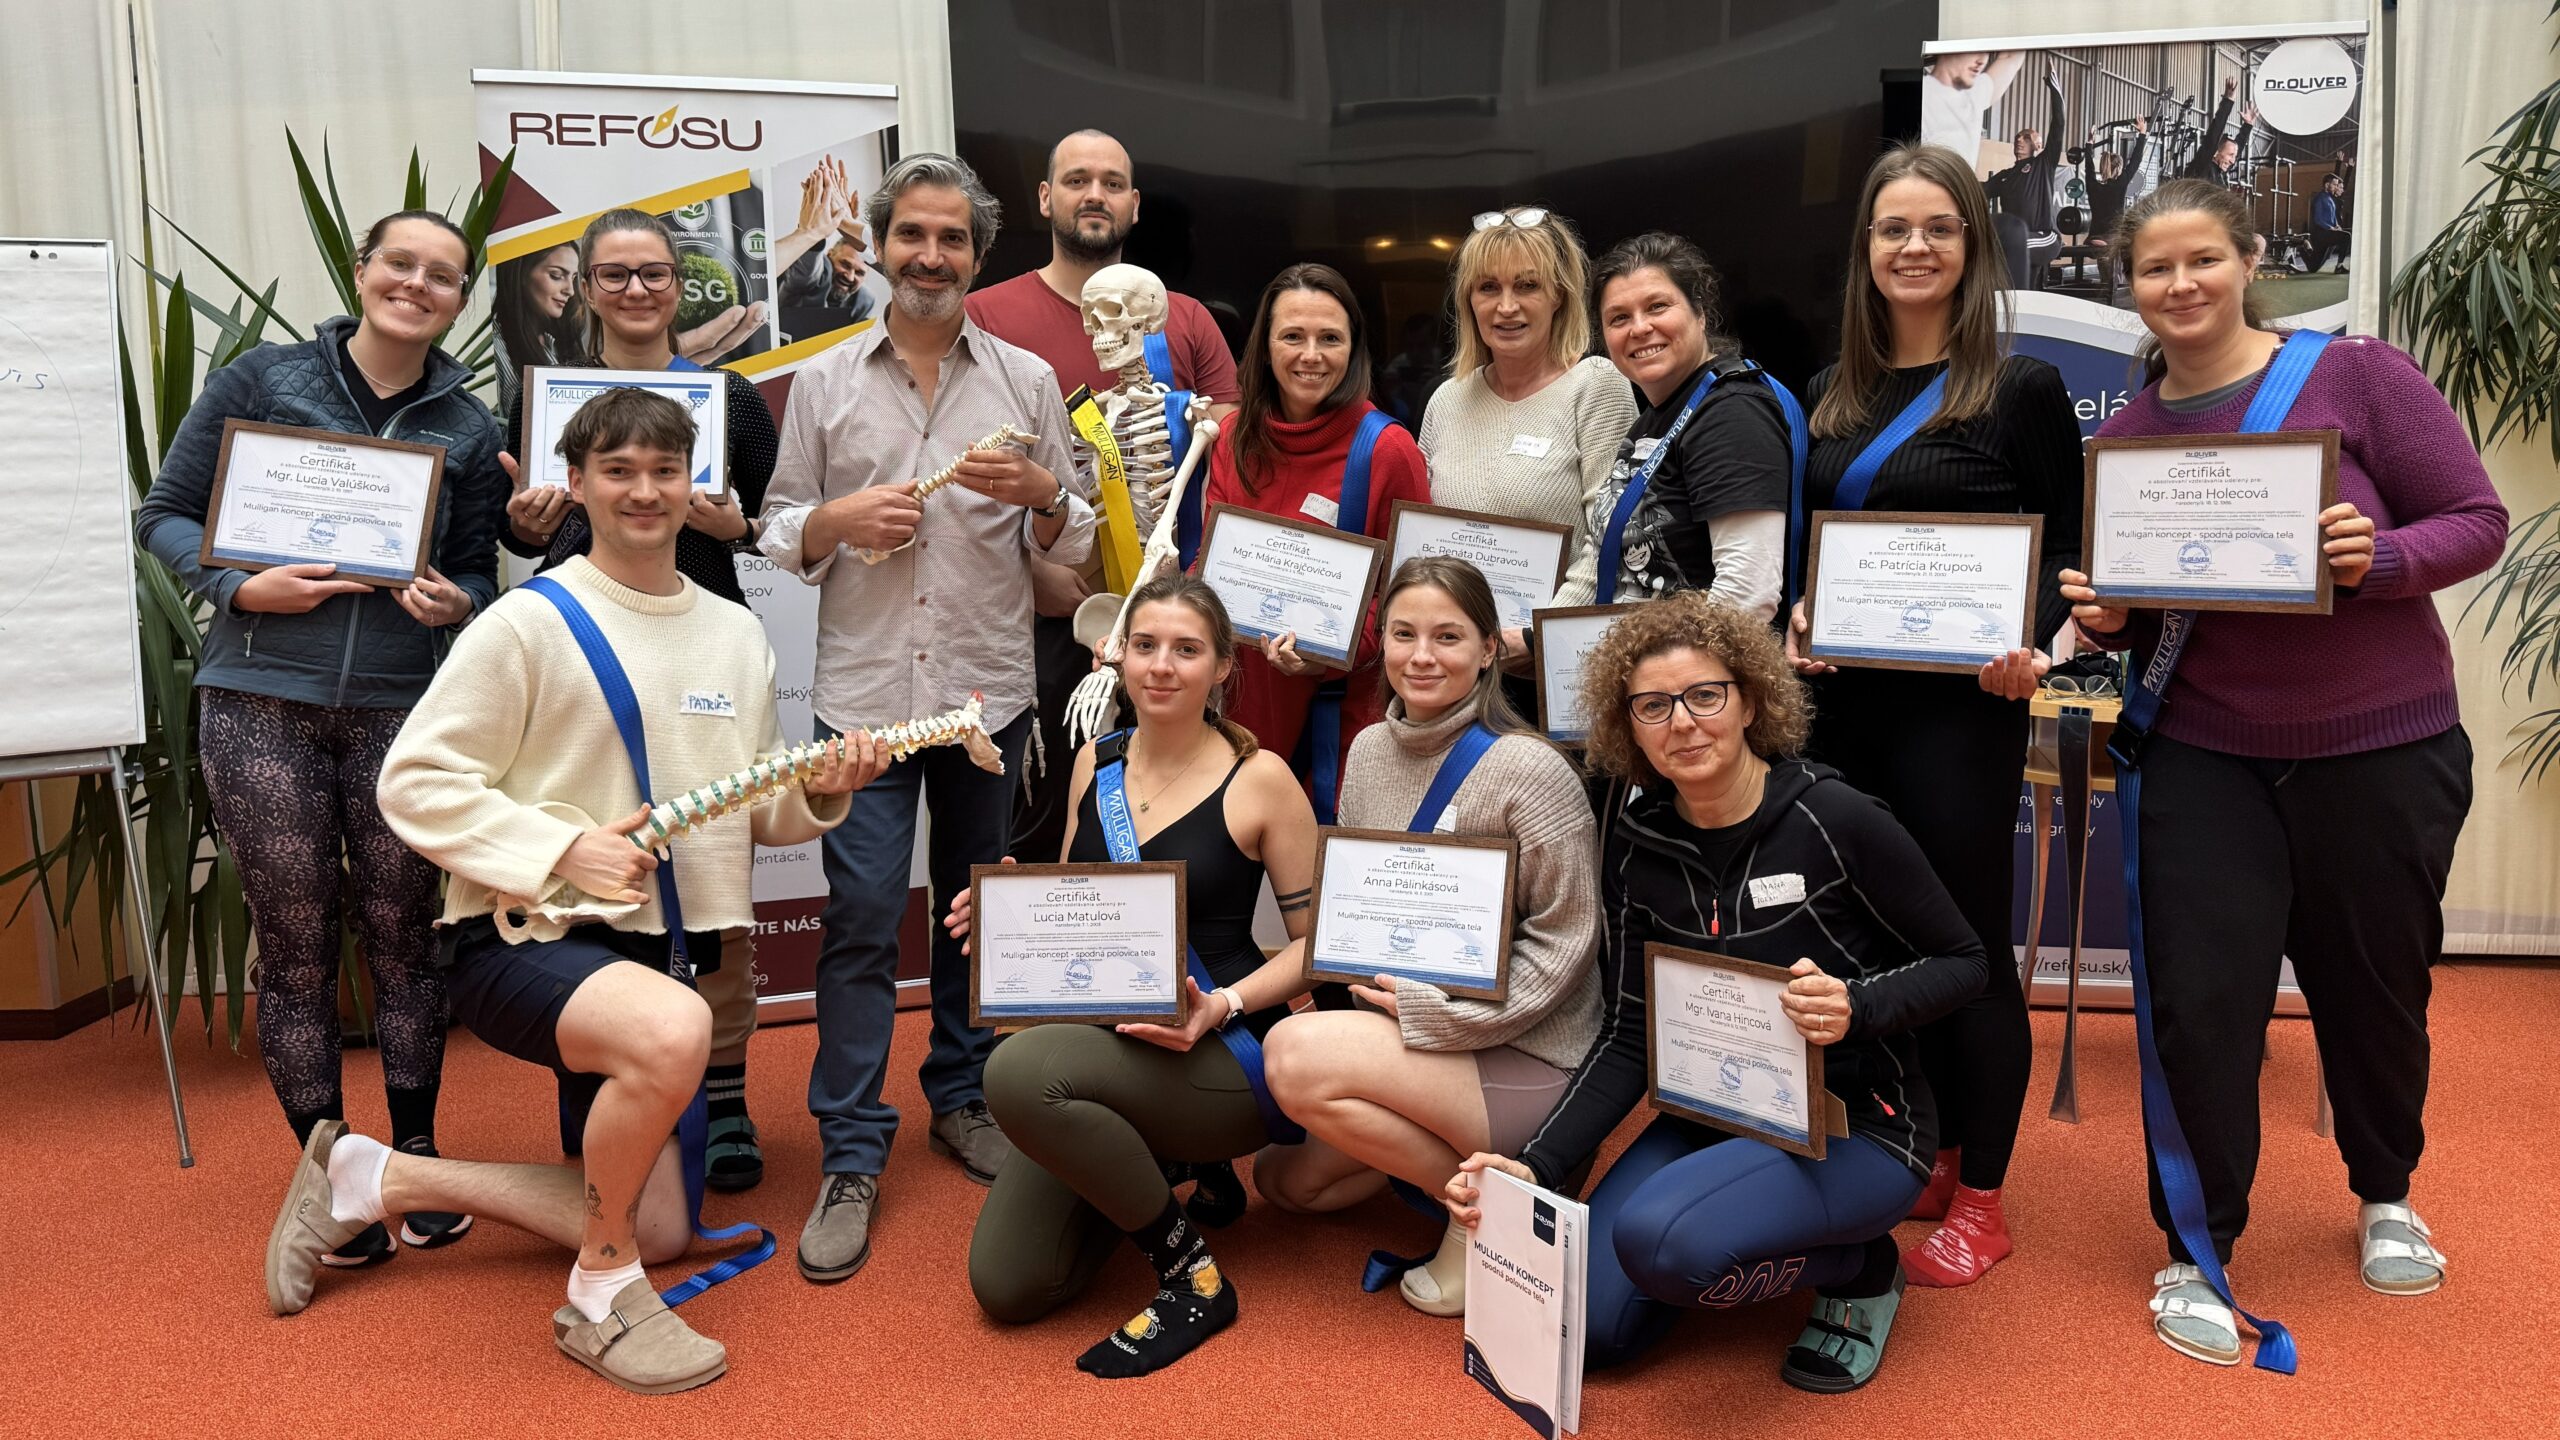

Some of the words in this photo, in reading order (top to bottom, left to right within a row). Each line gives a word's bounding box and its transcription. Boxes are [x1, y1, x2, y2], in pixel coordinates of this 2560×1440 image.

[2264, 76, 2347, 89] Dr.OLIVER
[510, 108, 762, 151] REFOSU
[684, 278, 727, 302] SG
[2067, 390, 2129, 420] elá
[1090, 423, 1119, 480] MULLIGAN
[300, 455, 356, 471] Certifikát
[2168, 466, 2231, 478] Certifikát
[266, 469, 293, 482] Mgr.
[296, 473, 328, 486] Lucia
[331, 477, 390, 493] Valúšková
[2140, 489, 2168, 502] Mgr.
[2171, 488, 2202, 500] Jana
[2206, 487, 2268, 499] Holecová
[243, 502, 279, 513] Mulligan
[280, 506, 314, 518] koncept
[321, 512, 351, 522] spodná
[353, 515, 386, 526] polovica
[387, 520, 402, 528] tela
[1451, 532, 1497, 547] Certifikát
[2116, 530, 2153, 539] Mulligan
[2155, 530, 2191, 539] koncept
[2200, 531, 2233, 539] spodná
[2235, 531, 2274, 539] polovica
[2276, 531, 2294, 539] tela
[1266, 538, 1310, 556] Certifikát
[1422, 543, 1436, 553] Bc.
[1439, 546, 1473, 560] Renáta
[1475, 551, 1529, 568] Dubravová
[1888, 541, 1947, 552] Certifikát
[1233, 546, 1253, 559] Mgr.
[1256, 552, 1281, 566] Mária
[1283, 557, 1342, 580] Krajčovičová
[1859, 559, 1877, 569] Bc.
[1880, 559, 1926, 571] Patrícia
[1930, 561, 1982, 574] Krupová
[1218, 575, 1246, 588] Mulligan
[1246, 582, 1273, 595] koncept
[1278, 590, 1302, 602] spodná
[1302, 595, 1329, 609] polovica
[1330, 602, 1342, 611] tela
[1494, 587, 1522, 598] polovica
[1523, 591, 1536, 599] tela
[1837, 596, 1872, 605] Mulligan
[1873, 597, 1908, 607] koncept
[1915, 600, 1947, 608] spodná
[1949, 600, 1984, 609] polovica
[1986, 601, 2002, 609] tela
[2148, 611, 2182, 692] MULLIGAN
[1108, 793, 1134, 863] MULLIGAN
[756, 850, 810, 865] entácie.
[1384, 858, 1435, 872] Certifikát
[1363, 876, 1392, 887] Anna
[1395, 878, 1459, 893] Pálinkásová
[1046, 891, 1101, 902] Certifikát
[784, 915, 822, 933] NÁS
[1034, 912, 1064, 922] Lucia
[1067, 910, 1120, 921] Matulová
[1337, 912, 1368, 921] Mulligan
[1370, 913, 1400, 923] koncept
[1405, 918, 1433, 926] spodná
[1435, 920, 1466, 930] polovica
[1001, 952, 1035, 960] Mulligan
[1036, 951, 1069, 960] koncept
[1076, 950, 1105, 958] spodná
[1107, 950, 1139, 958] polovica
[1141, 949, 1155, 957] tela
[1702, 984, 1745, 1004] Certifikát
[1685, 1001, 1705, 1016] Mgr.
[1706, 1006, 1732, 1021] Ivana
[1734, 1012, 1771, 1031] Hincová
[1671, 1038, 1696, 1051] Mulligan
[1697, 1045, 1722, 1058] koncept
[1752, 1059, 1779, 1073] polovica
[1780, 1066, 1792, 1077] tela
[1474, 1240, 1514, 1272] MULLIGAN
[1516, 1265, 1554, 1297] KONCEPT
[1481, 1259, 1504, 1279] spodná
[1505, 1274, 1532, 1295] polovica
[1533, 1291, 1545, 1304] tela
